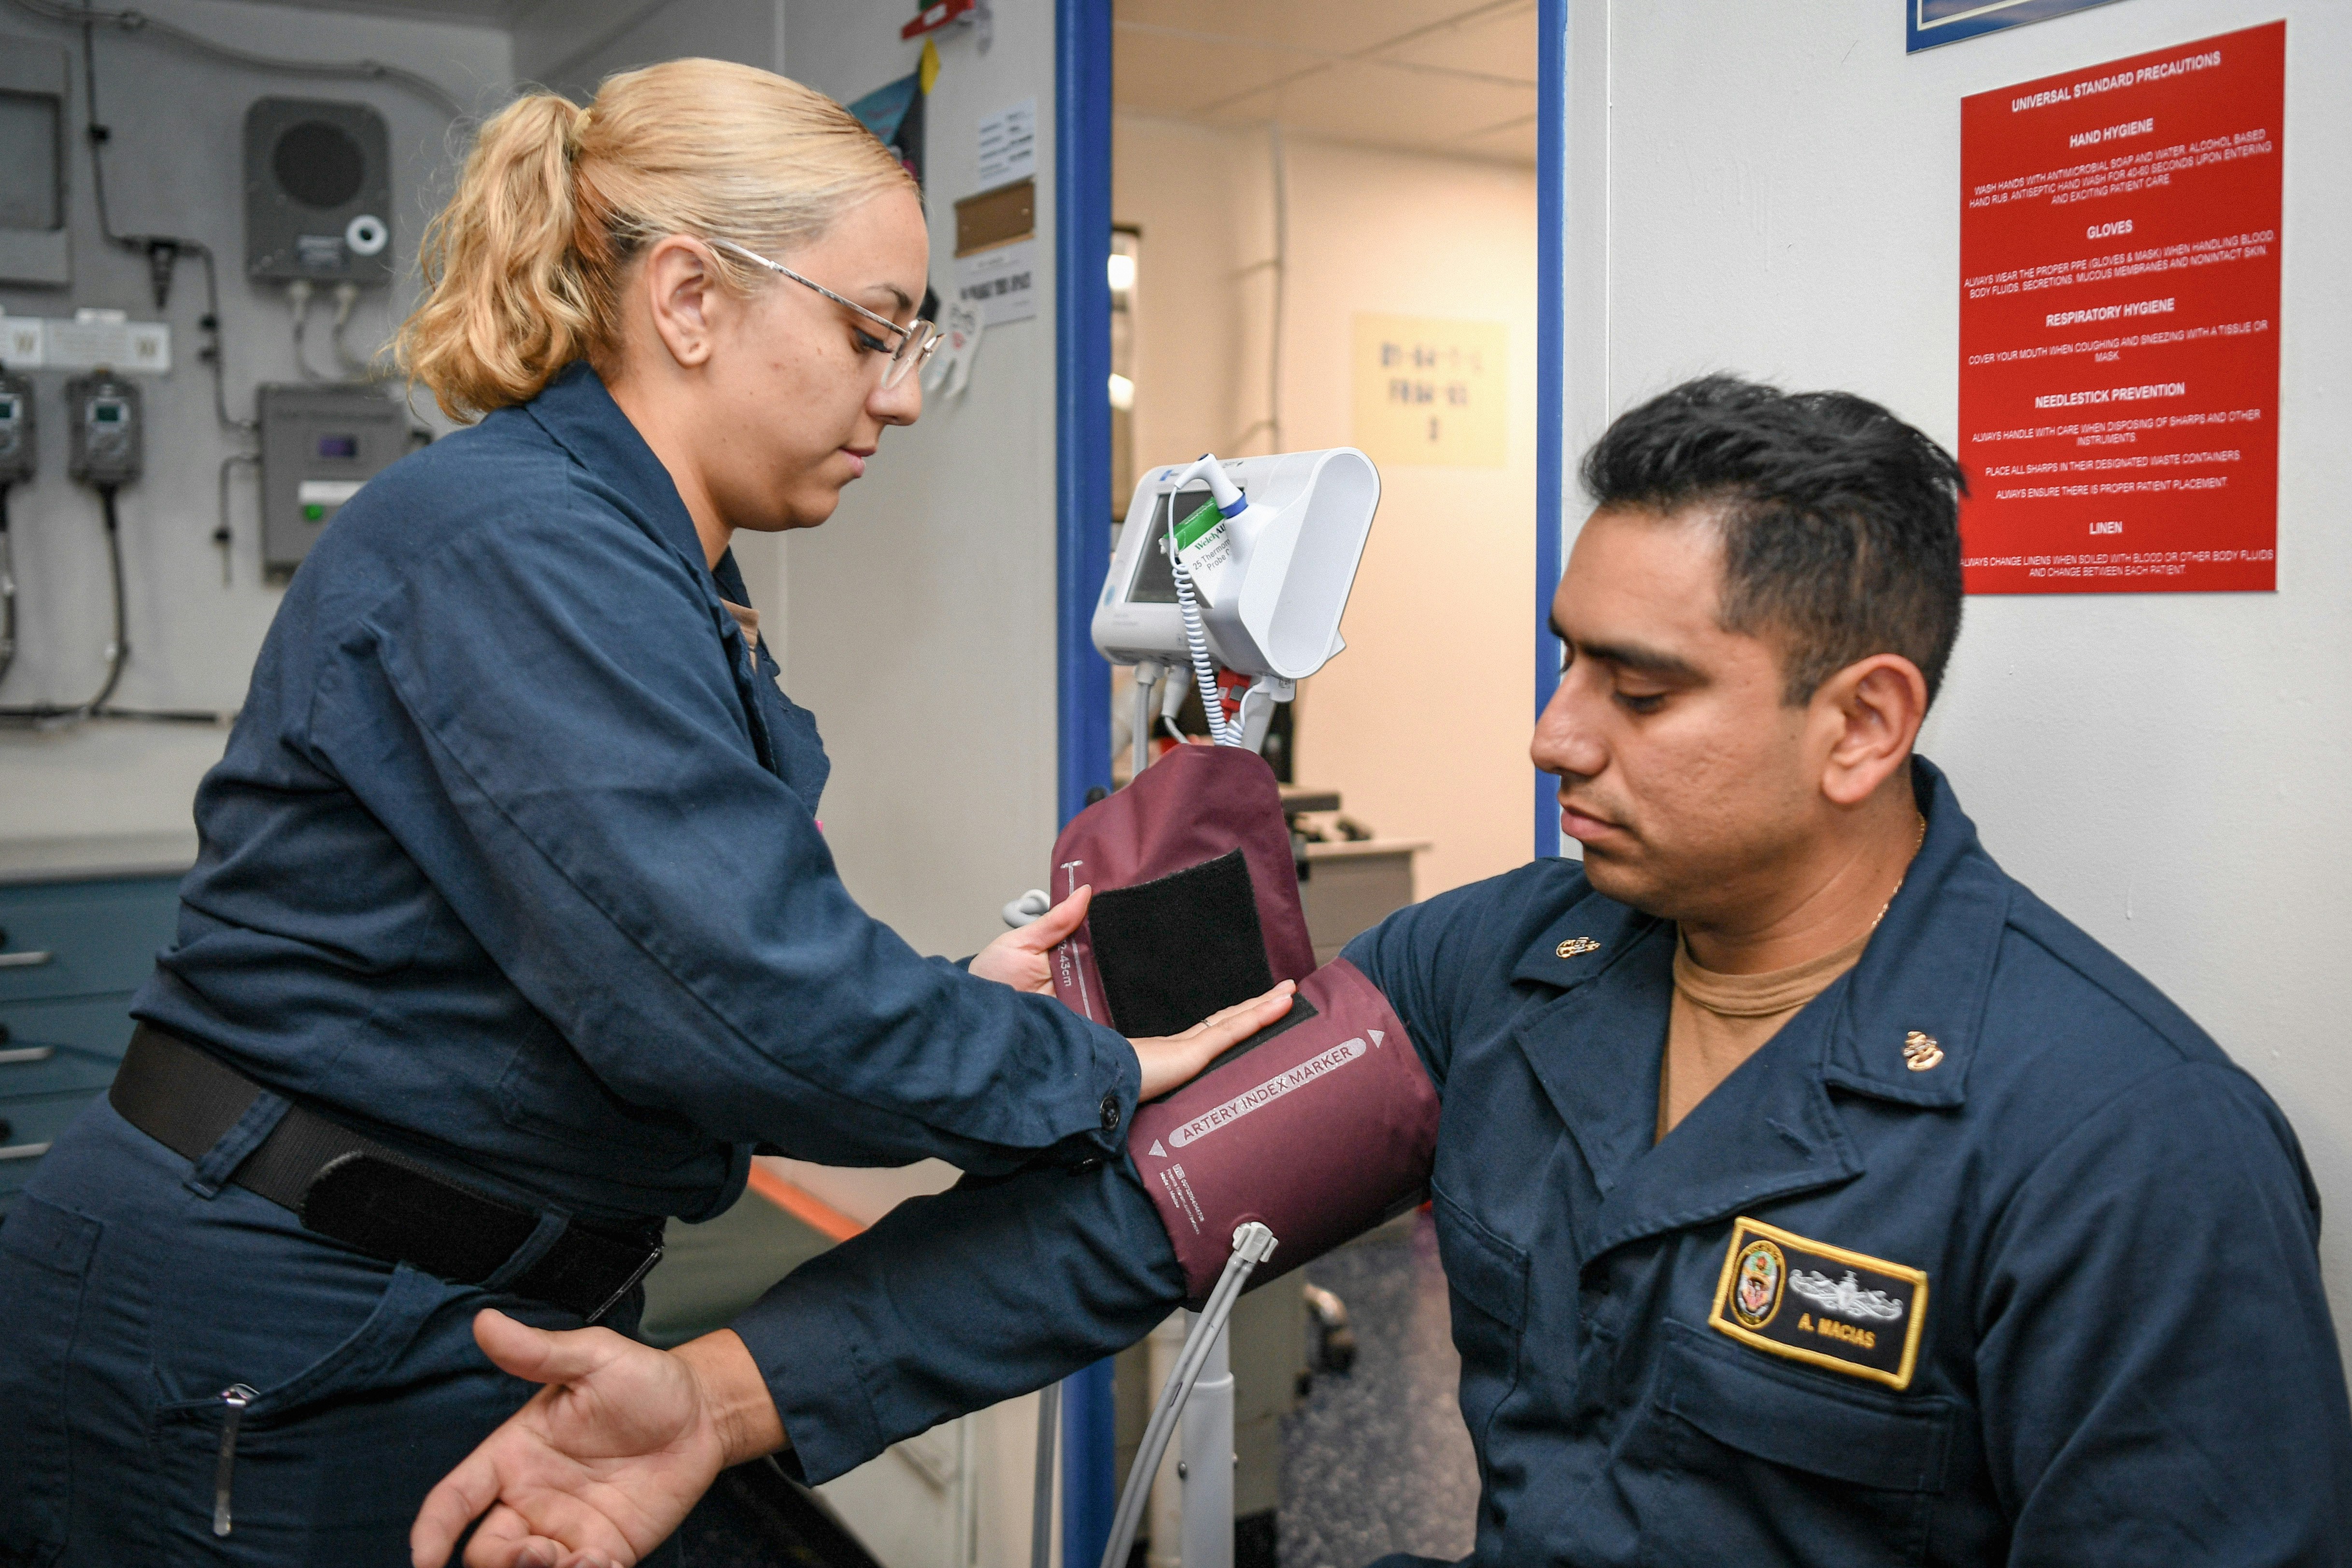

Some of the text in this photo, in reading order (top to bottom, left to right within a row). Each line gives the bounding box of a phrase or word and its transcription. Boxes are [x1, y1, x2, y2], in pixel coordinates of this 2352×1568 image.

[2012, 51, 2221, 113] UNIVERSAL STANDARD PRECAUTIONS
[2069, 117, 2154, 148] HAND HYGIENE
[1969, 196, 1991, 208] HAND
[2011, 183, 2056, 200] ANTISEPTIC
[2057, 178, 2081, 191] HAND
[2082, 174, 2106, 186] WASH
[2107, 169, 2126, 181] FOR
[2151, 155, 2194, 174] SECONDS
[2196, 151, 2222, 166] UPON
[2223, 141, 2271, 160] ENTERING
[1974, 183, 1997, 196] WASH
[1997, 177, 2025, 190] HANDS
[2026, 173, 2046, 185] WITH
[2046, 163, 2108, 181] ANTIMICROBIAL
[2111, 155, 2134, 169] SOAP
[2135, 151, 2153, 163] AND
[2189, 136, 2232, 153] ALCOHOL
[2233, 128, 2266, 145] BASED
[2051, 193, 2069, 204] AND
[2109, 178, 2144, 193] PATIENT
[2086, 219, 2133, 240] GLOVES
[1965, 274, 1994, 287] ALWAYS
[1995, 270, 2018, 283] WEAR
[2019, 267, 2035, 279] THE
[2035, 262, 2069, 276] PROPER
[2070, 259, 2087, 270] PPE
[2125, 252, 2134, 263] &
[2163, 243, 2191, 257] WHEN
[2192, 235, 2239, 252] HANDLING
[1969, 286, 1991, 299] BODY
[2076, 268, 2113, 283] MUCOUS
[2113, 259, 2169, 277] MEMBRANES
[2168, 256, 2189, 268] AND
[2189, 247, 2242, 266] NONINTACT
[2045, 297, 2175, 327] RESPIRATORY HYGIENE
[1969, 319, 2268, 365] COVER YOUR MOUTH WHEN COUGHING AND SNEEZING WITH A TISSUE OR
[2035, 382, 2185, 409] NEEDLESTICK PREVENTION
[1972, 409, 2261, 442] ALWAYS HANDLE WITH CARE WHEN DISPOSING OF SHARPS AND OTHER
[1985, 466, 2011, 477] PLACE
[2010, 465, 2026, 475] ALL
[2026, 462, 2058, 474] SHARPS
[2059, 462, 2069, 471] IN
[2069, 460, 2094, 471] THEIR
[2095, 456, 2149, 470] DESIGNATED
[2150, 453, 2181, 466] WASTE
[1996, 488, 2027, 500] ALWAYS
[2027, 486, 2060, 498] ENSURE
[2061, 484, 2089, 496] THERE
[2090, 484, 2099, 495] IS
[2099, 482, 2135, 494] PROPER
[2136, 480, 2171, 492] PATIENT
[2089, 521, 2123, 535] LINEN
[1192, 560, 1202, 570] 25
[1206, 554, 1226, 571] Probe
[1989, 556, 2022, 566] CHANGE
[2023, 555, 2052, 566] LINENS
[2053, 554, 2077, 565] WHEN
[2078, 553, 2109, 565] SOILED
[2110, 553, 2132, 563] WITH
[2133, 552, 2163, 564] BLOOD
[2165, 551, 2178, 563] OR
[2180, 551, 2211, 562] OTHER
[2212, 550, 2239, 562] BODY
[2239, 549, 2272, 561] FLUIDS
[2029, 567, 2046, 578] AND
[2047, 566, 2081, 577] CHANGE
[2083, 565, 2123, 576] BETWEEN
[2125, 565, 2149, 576] EACH
[1182, 1046, 1353, 1141] ARTERY INDEX MARKER
[1798, 1312, 1876, 1350] A. MACIAS
